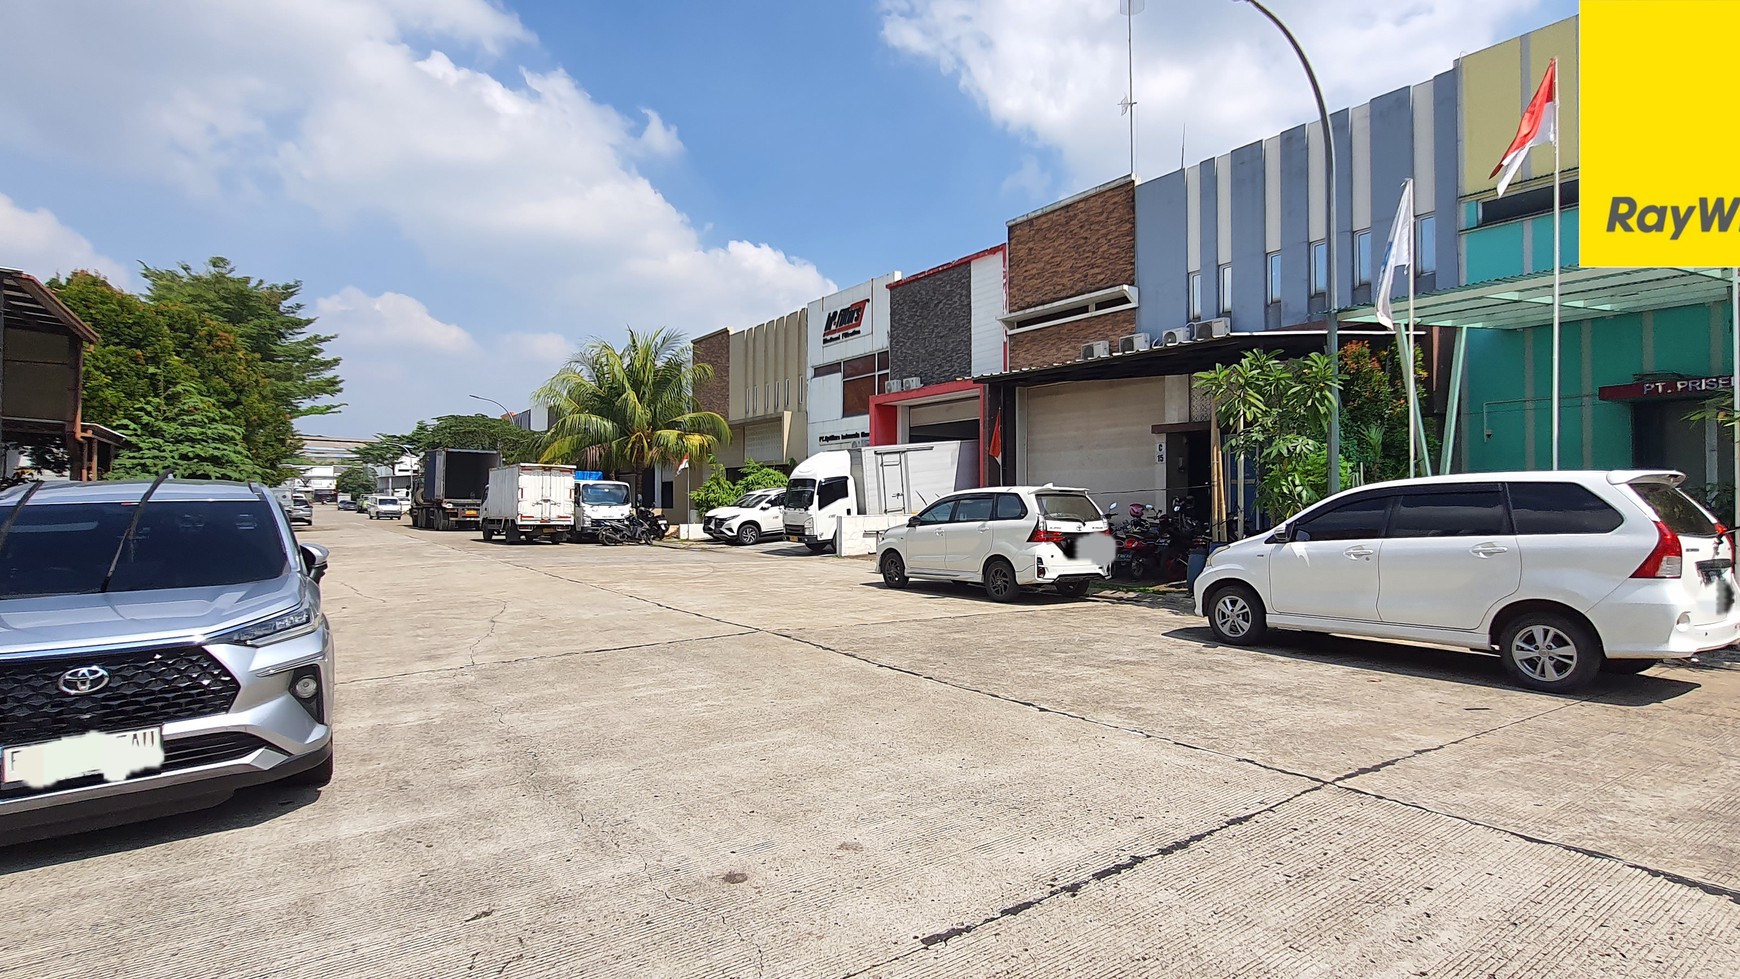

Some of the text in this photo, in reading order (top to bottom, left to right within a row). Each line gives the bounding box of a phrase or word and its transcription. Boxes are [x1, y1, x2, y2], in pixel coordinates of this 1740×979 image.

[1643, 376, 1734, 395] PT. PRISE
[1158, 443, 1163, 452] C
[1157, 454, 1164, 463] 15
